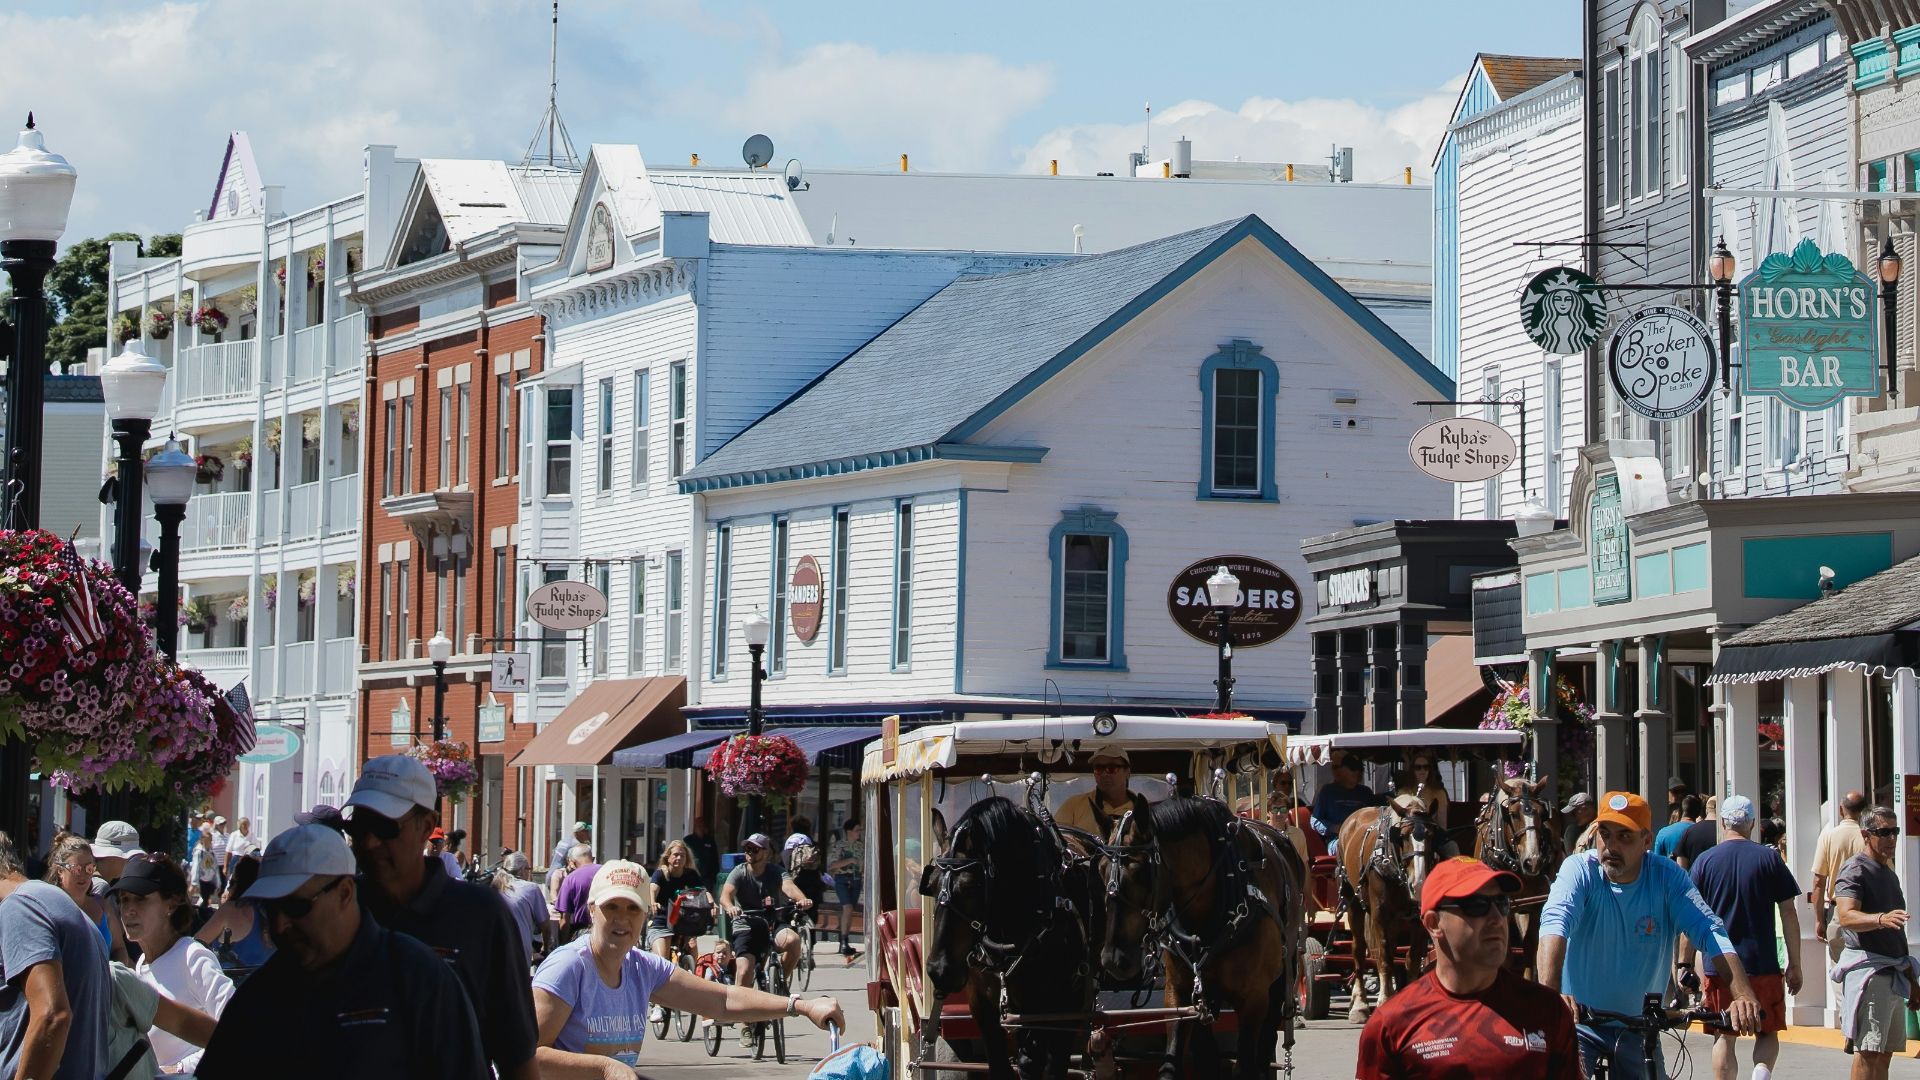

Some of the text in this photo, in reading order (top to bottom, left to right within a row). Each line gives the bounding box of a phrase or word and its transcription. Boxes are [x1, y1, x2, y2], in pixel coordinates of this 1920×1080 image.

[1750, 286, 1867, 319] HORN'S
[1617, 315, 1638, 337] WHISKEY
[1642, 308, 1658, 317] WINE
[1664, 307, 1691, 320] BOURBON
[1694, 322, 1709, 338] BEER
[1643, 320, 1666, 337] The
[1620, 326, 1696, 369] Broken
[1769, 327, 1852, 349] Gaslight
[1632, 351, 1702, 405] Spoke
[1779, 355, 1844, 387] BAR
[1680, 382, 1693, 390] 2019
[1626, 398, 1654, 417] MACKINAC
[1676, 398, 1702, 417] MICHIGAN
[1440, 425, 1488, 450] Ryba's
[1418, 446, 1509, 470] Fudge Shops
[1229, 564, 1250, 572] WORTH
[1253, 566, 1280, 578] SHARING
[551, 586, 586, 605] Ryba's
[1176, 586, 1295, 609] SADERS
[1329, 568, 1369, 606] STARBUCKS
[534, 602, 601, 620] Fudge Shops
